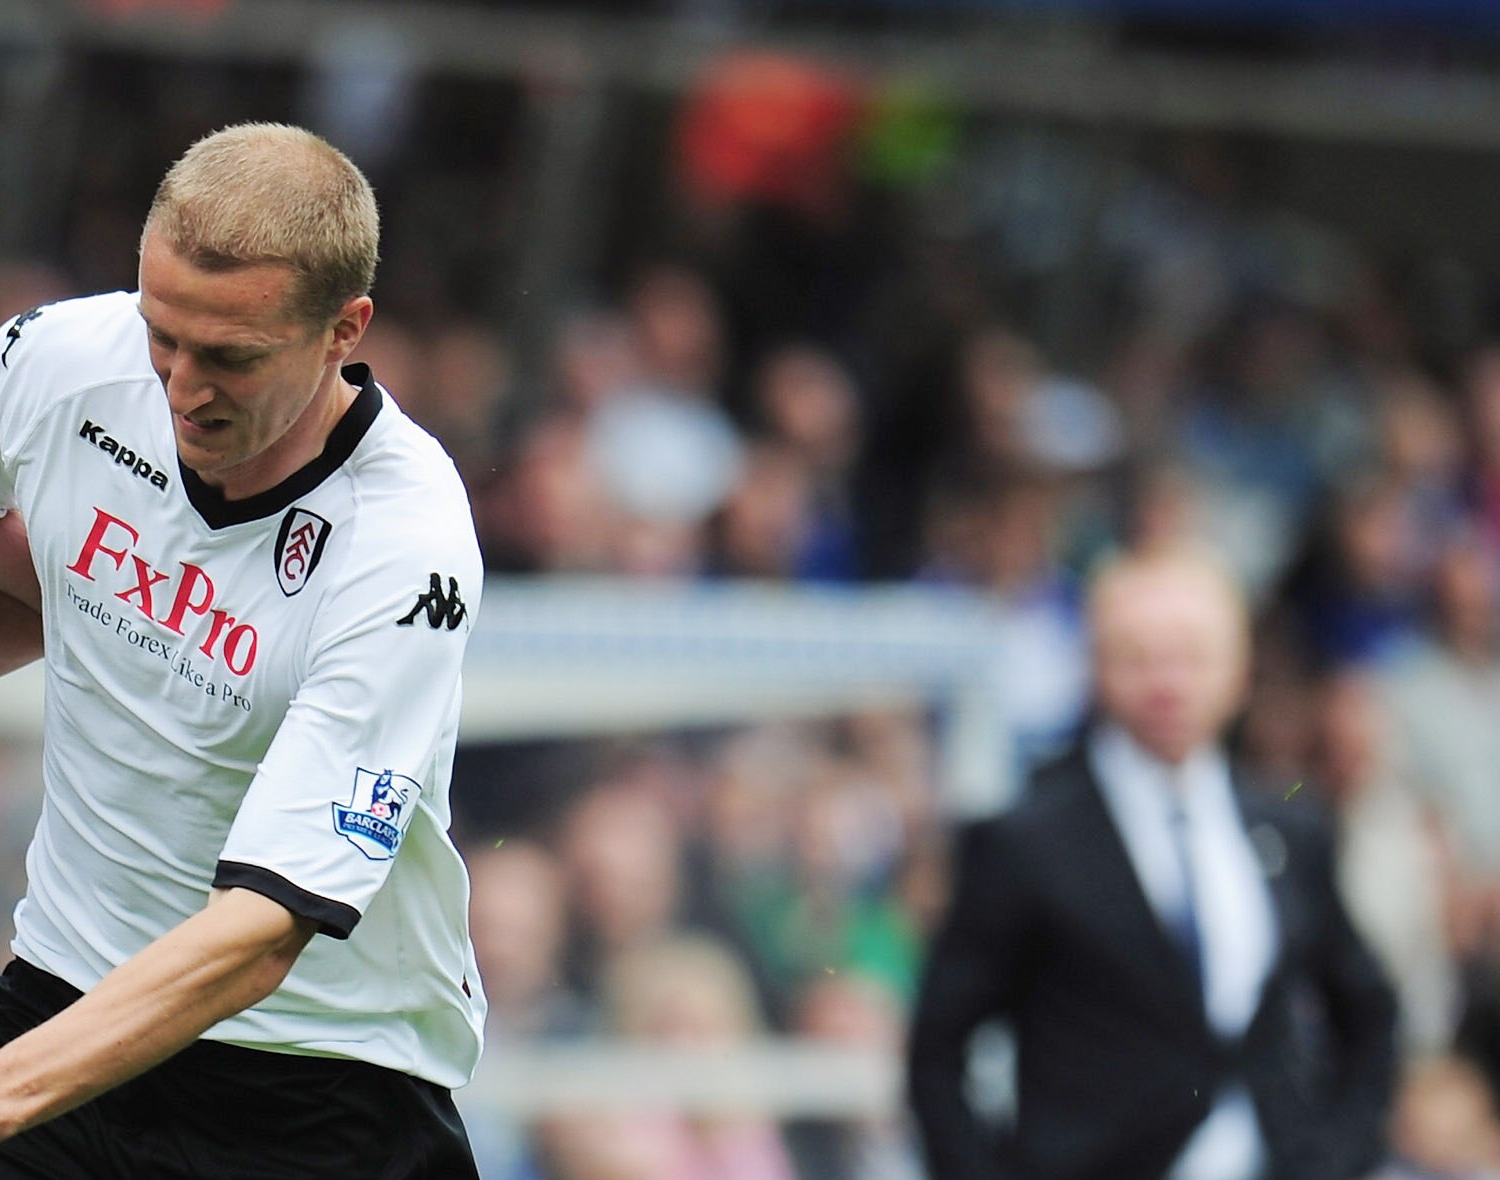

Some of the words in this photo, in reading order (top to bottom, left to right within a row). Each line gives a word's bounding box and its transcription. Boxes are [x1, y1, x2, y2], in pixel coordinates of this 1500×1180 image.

[78, 418, 169, 492] Kappa
[65, 505, 259, 678] FxPro
[65, 579, 112, 627] Trade
[115, 616, 170, 661] Forex
[205, 682, 217, 697] a
[221, 682, 252, 713] Pro
